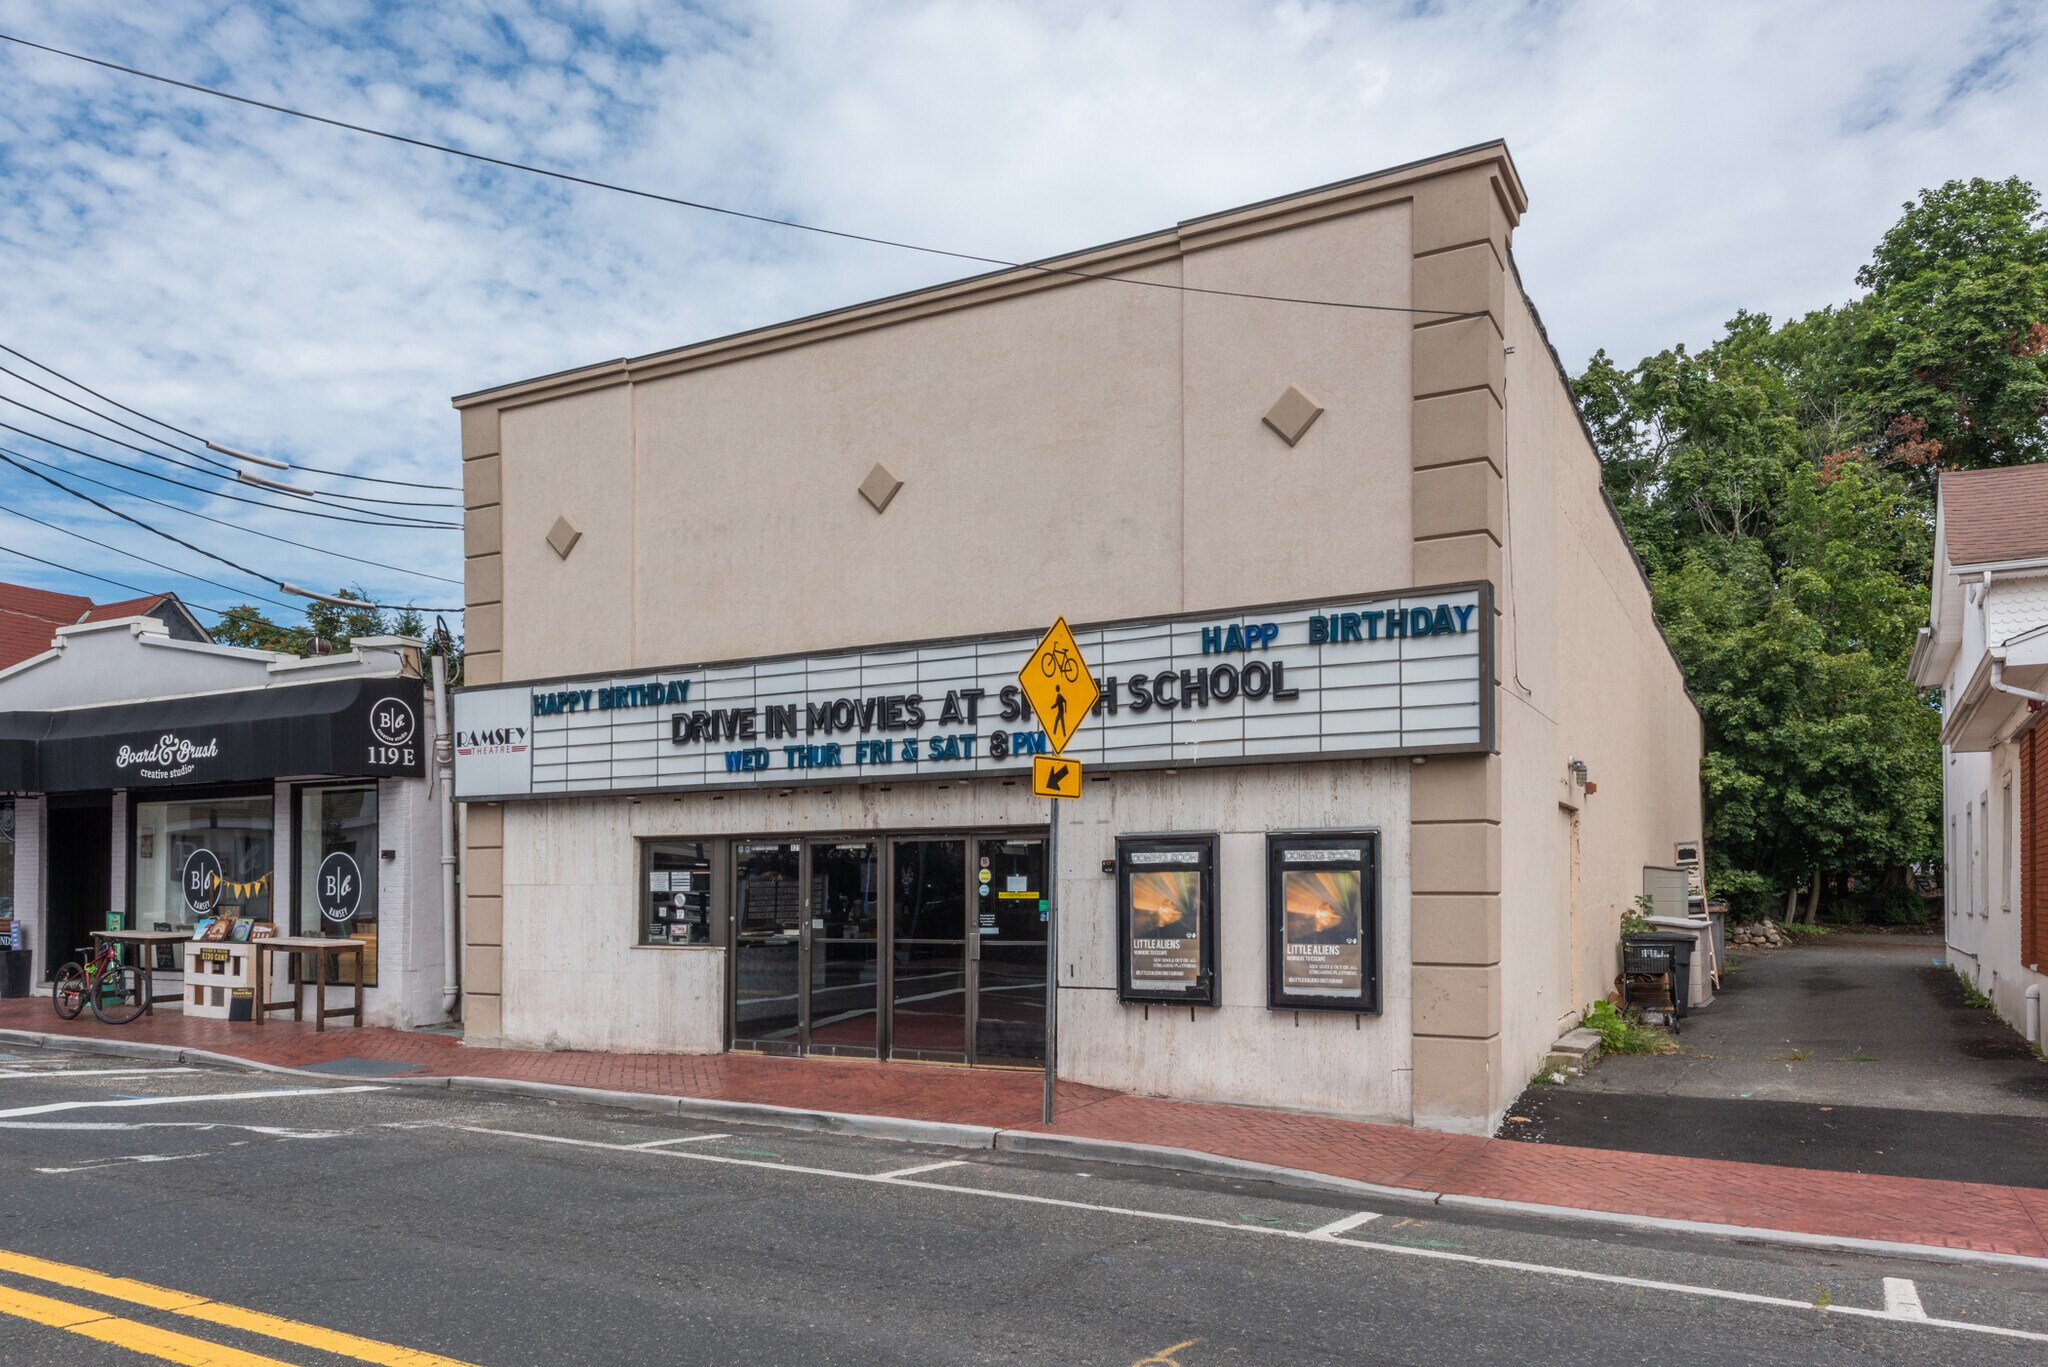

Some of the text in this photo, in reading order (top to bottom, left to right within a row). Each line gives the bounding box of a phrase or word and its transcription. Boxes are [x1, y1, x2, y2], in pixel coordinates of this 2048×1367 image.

[1201, 604, 1475, 655] HAPP BIRTHDAY
[533, 679, 690, 716] HAPPY BIRTHDAY
[672, 707, 757, 744] DRIVE
[765, 703, 797, 739] IN
[806, 693, 926, 736] MOVIES
[938, 687, 985, 726] AT
[1128, 660, 1300, 714] SCHOOL
[456, 726, 529, 748] RAMSEY
[116, 733, 218, 768] Board & Brush
[368, 746, 416, 766] 119 E
[472, 745, 511, 755] THEATRE
[724, 746, 769, 773] WED
[783, 742, 842, 769] THUR
[855, 738, 893, 765] FRI
[901, 737, 919, 762] &
[928, 733, 977, 760] SAT
[140, 768, 169, 779] creative
[1131, 852, 1198, 863] COMING SOON
[1285, 849, 1358, 861] COMING SOON
[193, 900, 210, 911] RAMSEY
[329, 907, 348, 917] RAMSEY
[1133, 939, 1181, 949] LITTLE ALIENS
[1287, 944, 1340, 955] LITTLE ALIENS
